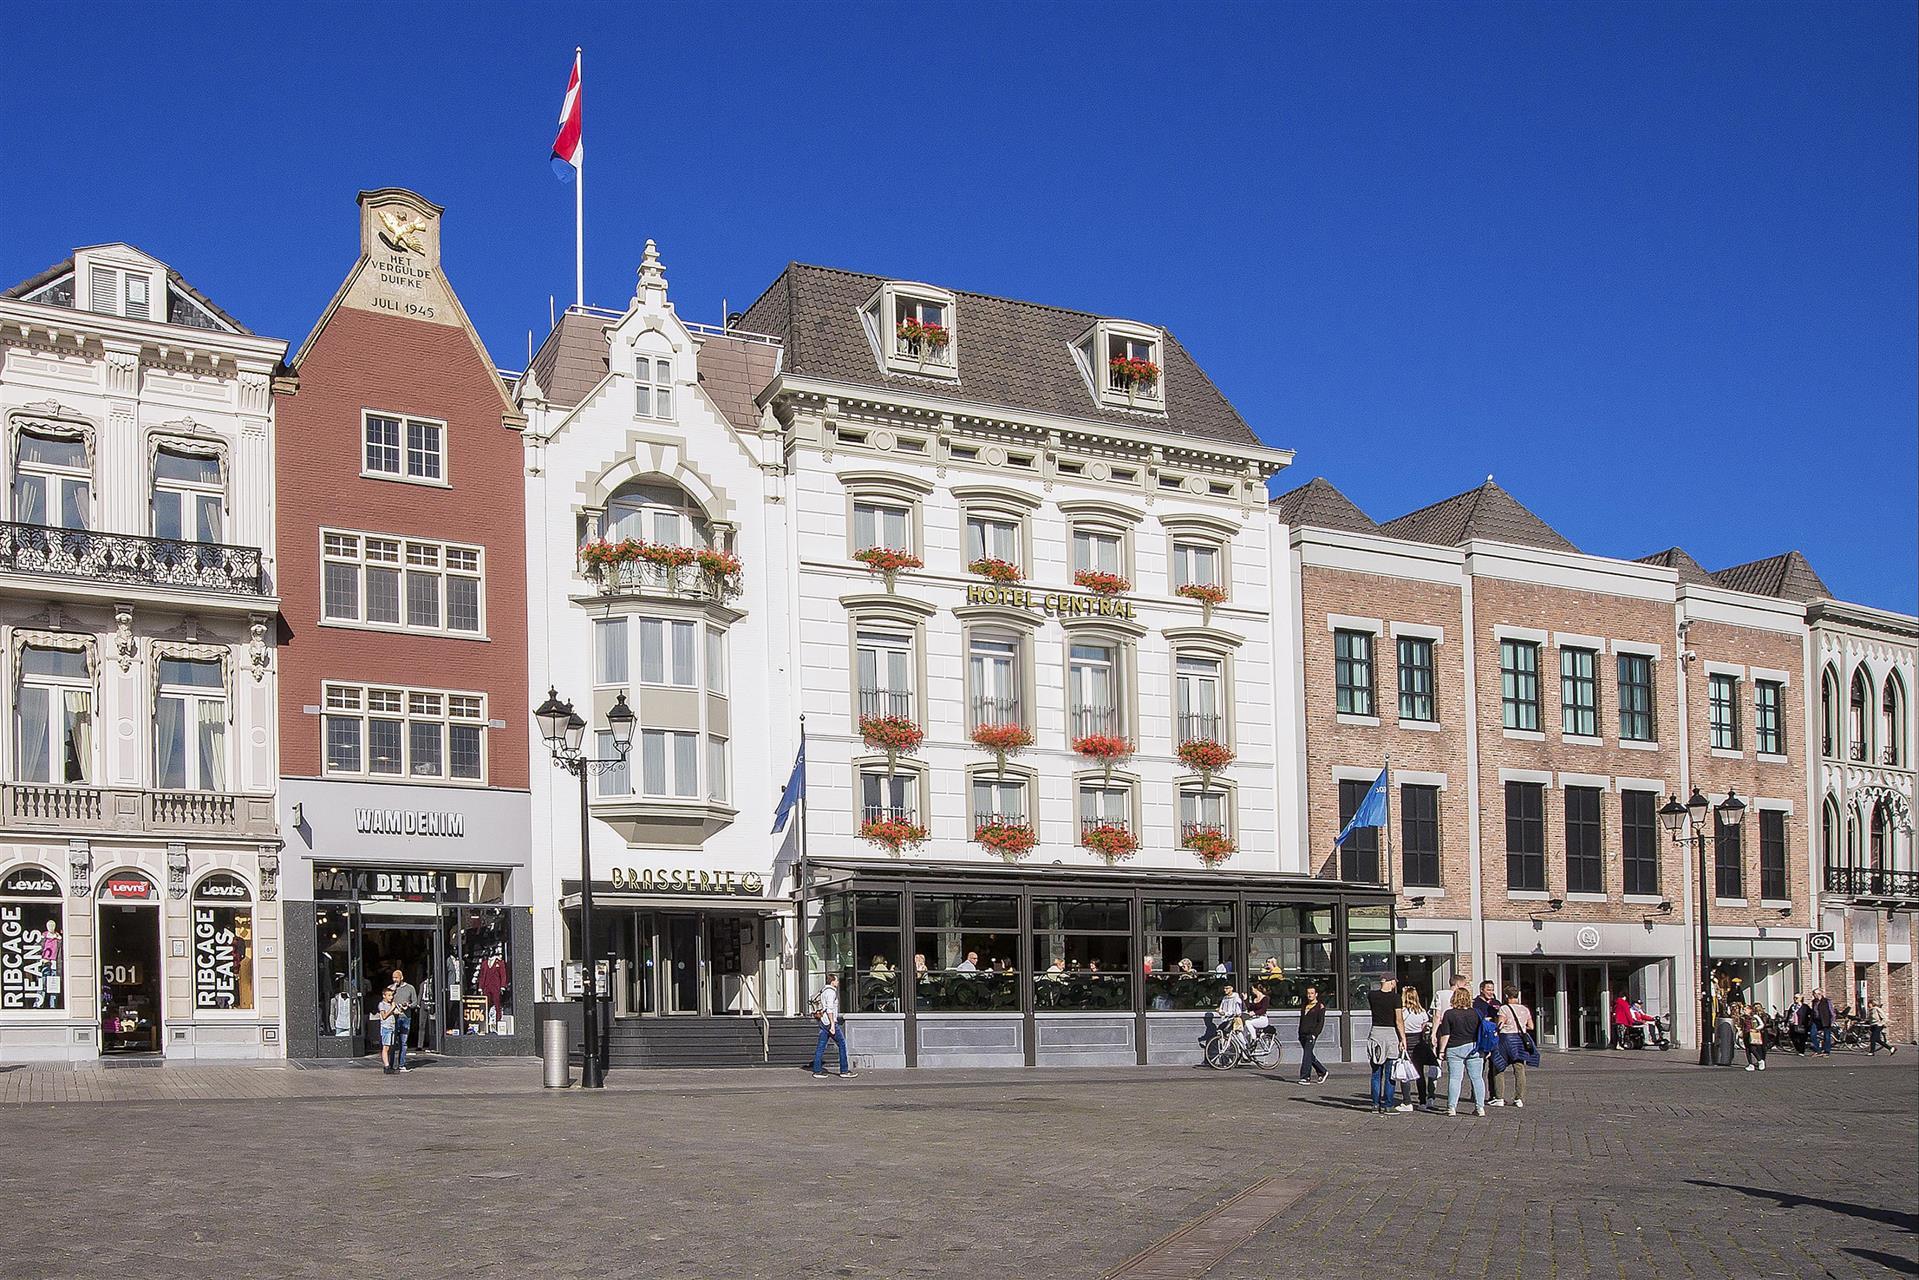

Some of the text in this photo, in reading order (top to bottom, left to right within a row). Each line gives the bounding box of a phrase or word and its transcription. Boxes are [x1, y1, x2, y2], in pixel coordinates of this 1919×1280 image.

[371, 260, 431, 280] VERGULDE
[390, 255, 411, 267] HET
[380, 273, 422, 289] DUIFKE
[371, 297, 434, 318] JULI 1945
[967, 585, 1137, 618] HOTEL CENTRAL
[355, 808, 464, 837] WAM DENIM
[611, 867, 736, 892] BRASSERIE
[1, 907, 24, 1007] RIBCAGE
[22, 929, 45, 1007] JEANS
[196, 909, 216, 1006] RIBCAGE
[215, 927, 235, 1006] JEANS
[103, 965, 136, 983] 501
[463, 1008, 485, 1022] 50%
